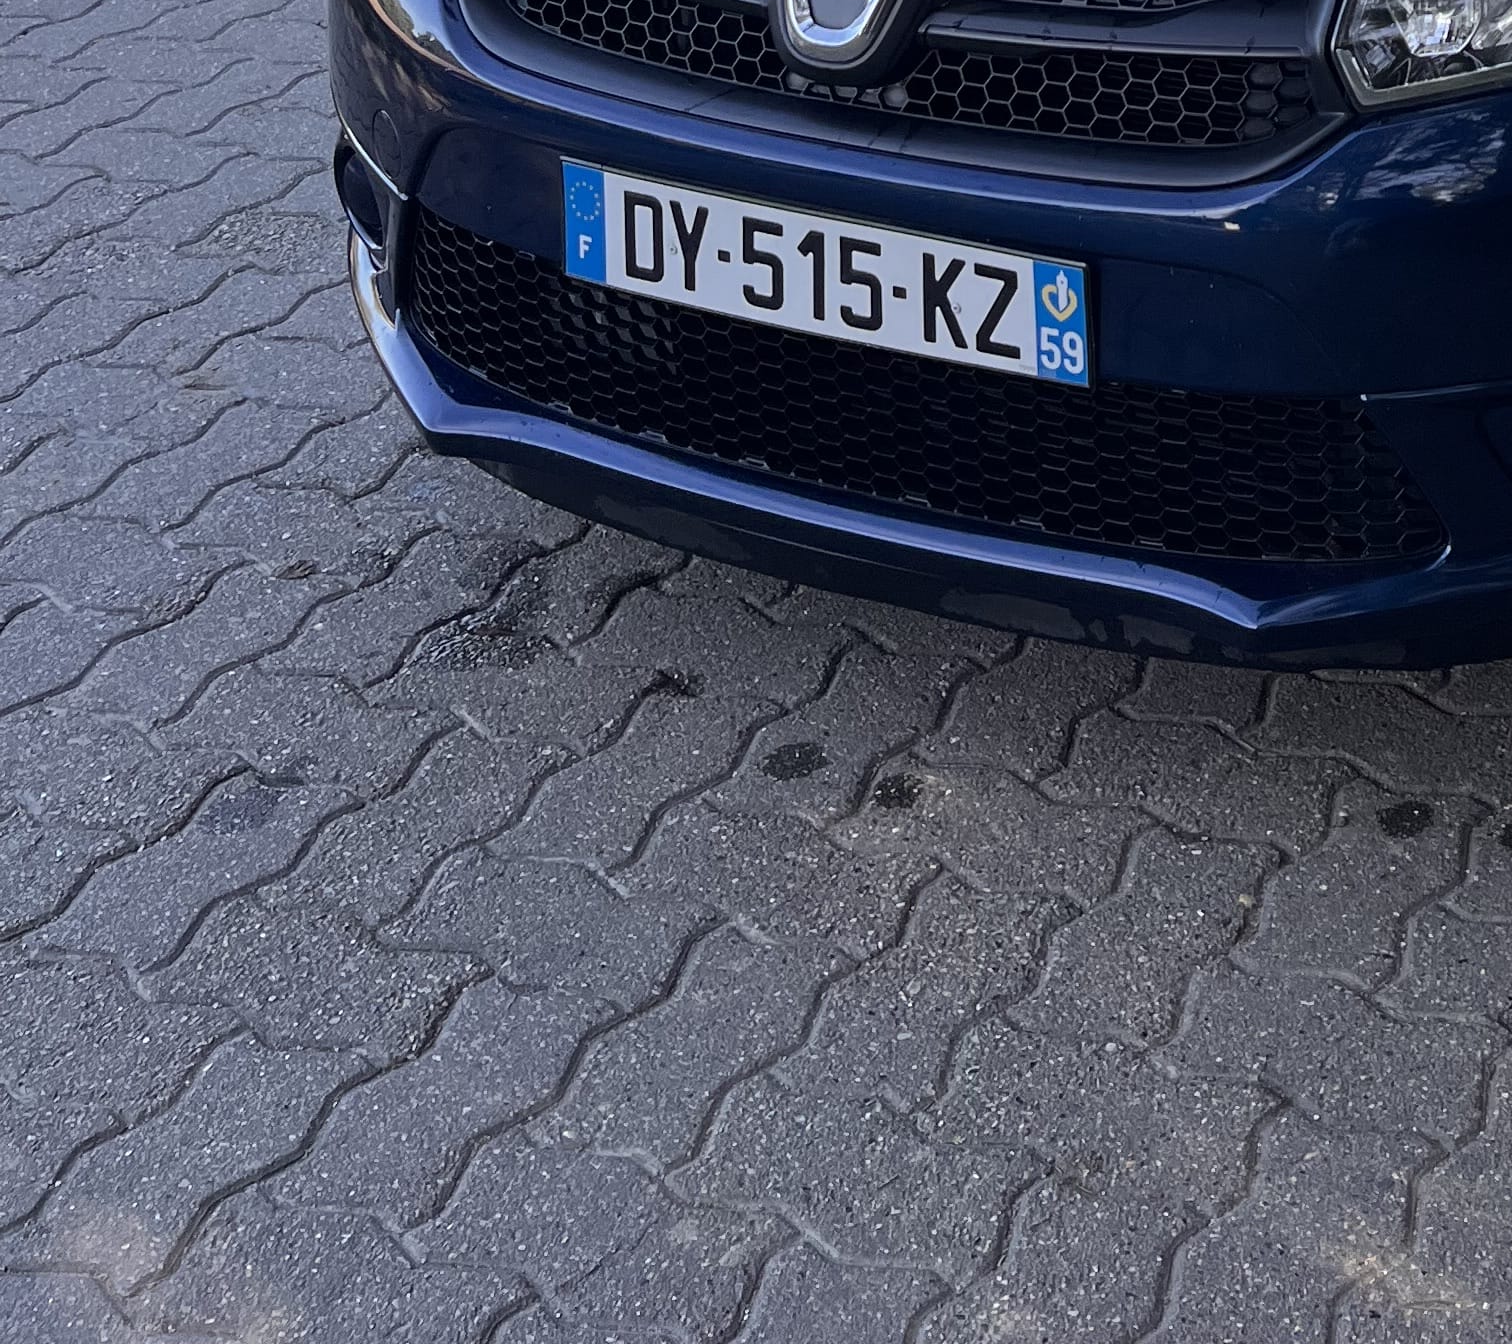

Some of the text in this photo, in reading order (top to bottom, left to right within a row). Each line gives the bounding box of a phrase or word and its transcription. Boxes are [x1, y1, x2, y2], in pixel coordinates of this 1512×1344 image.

[578, 233, 593, 260] F
[623, 190, 1021, 360] DY-515-KZ
[1040, 325, 1085, 375] 59
